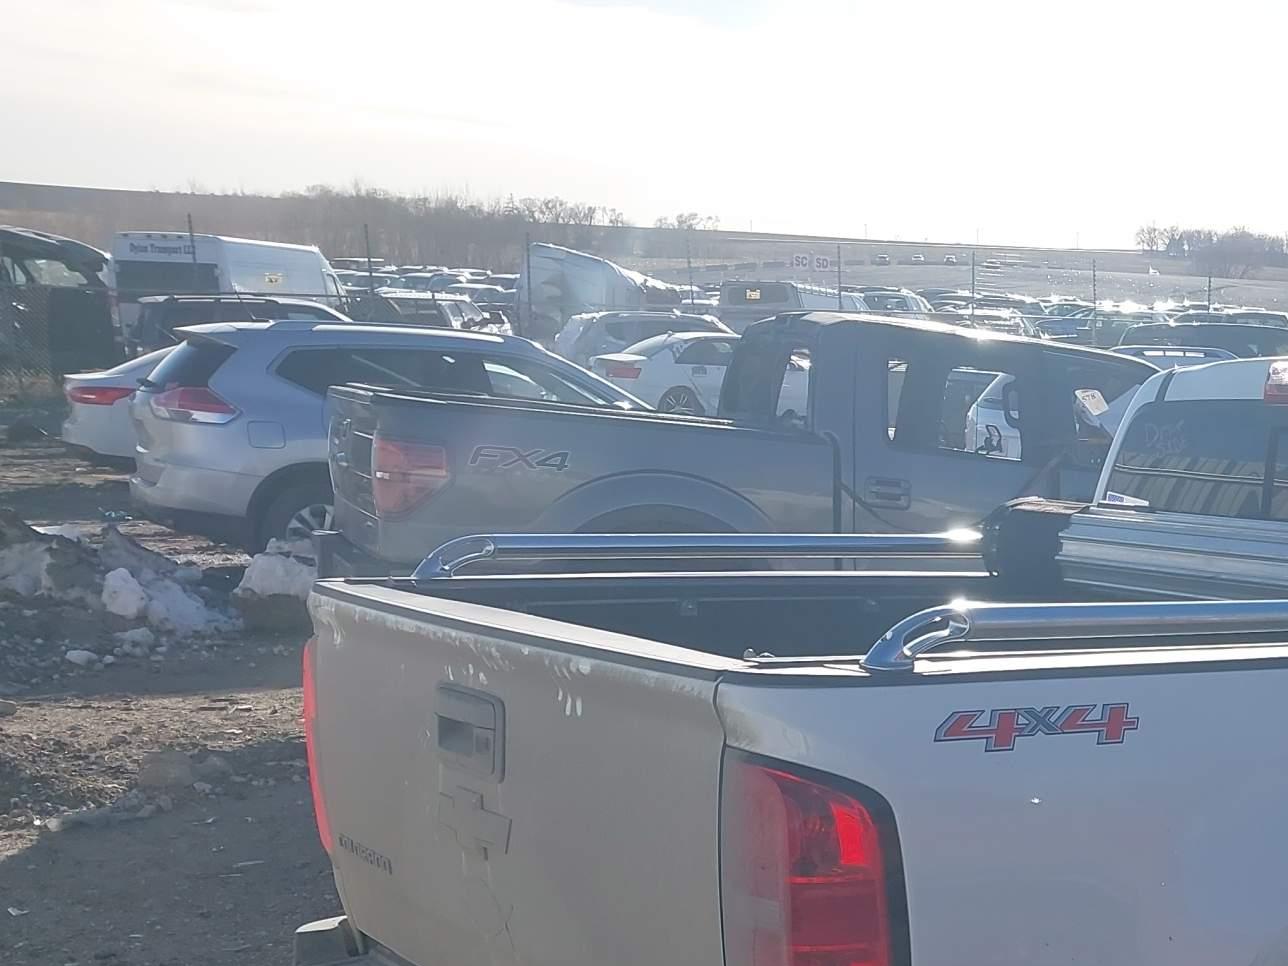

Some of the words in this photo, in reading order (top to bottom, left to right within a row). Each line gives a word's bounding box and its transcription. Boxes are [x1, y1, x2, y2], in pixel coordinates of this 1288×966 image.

[794, 255, 808, 267] SC
[816, 257, 829, 269] SD
[467, 444, 571, 472] FX4
